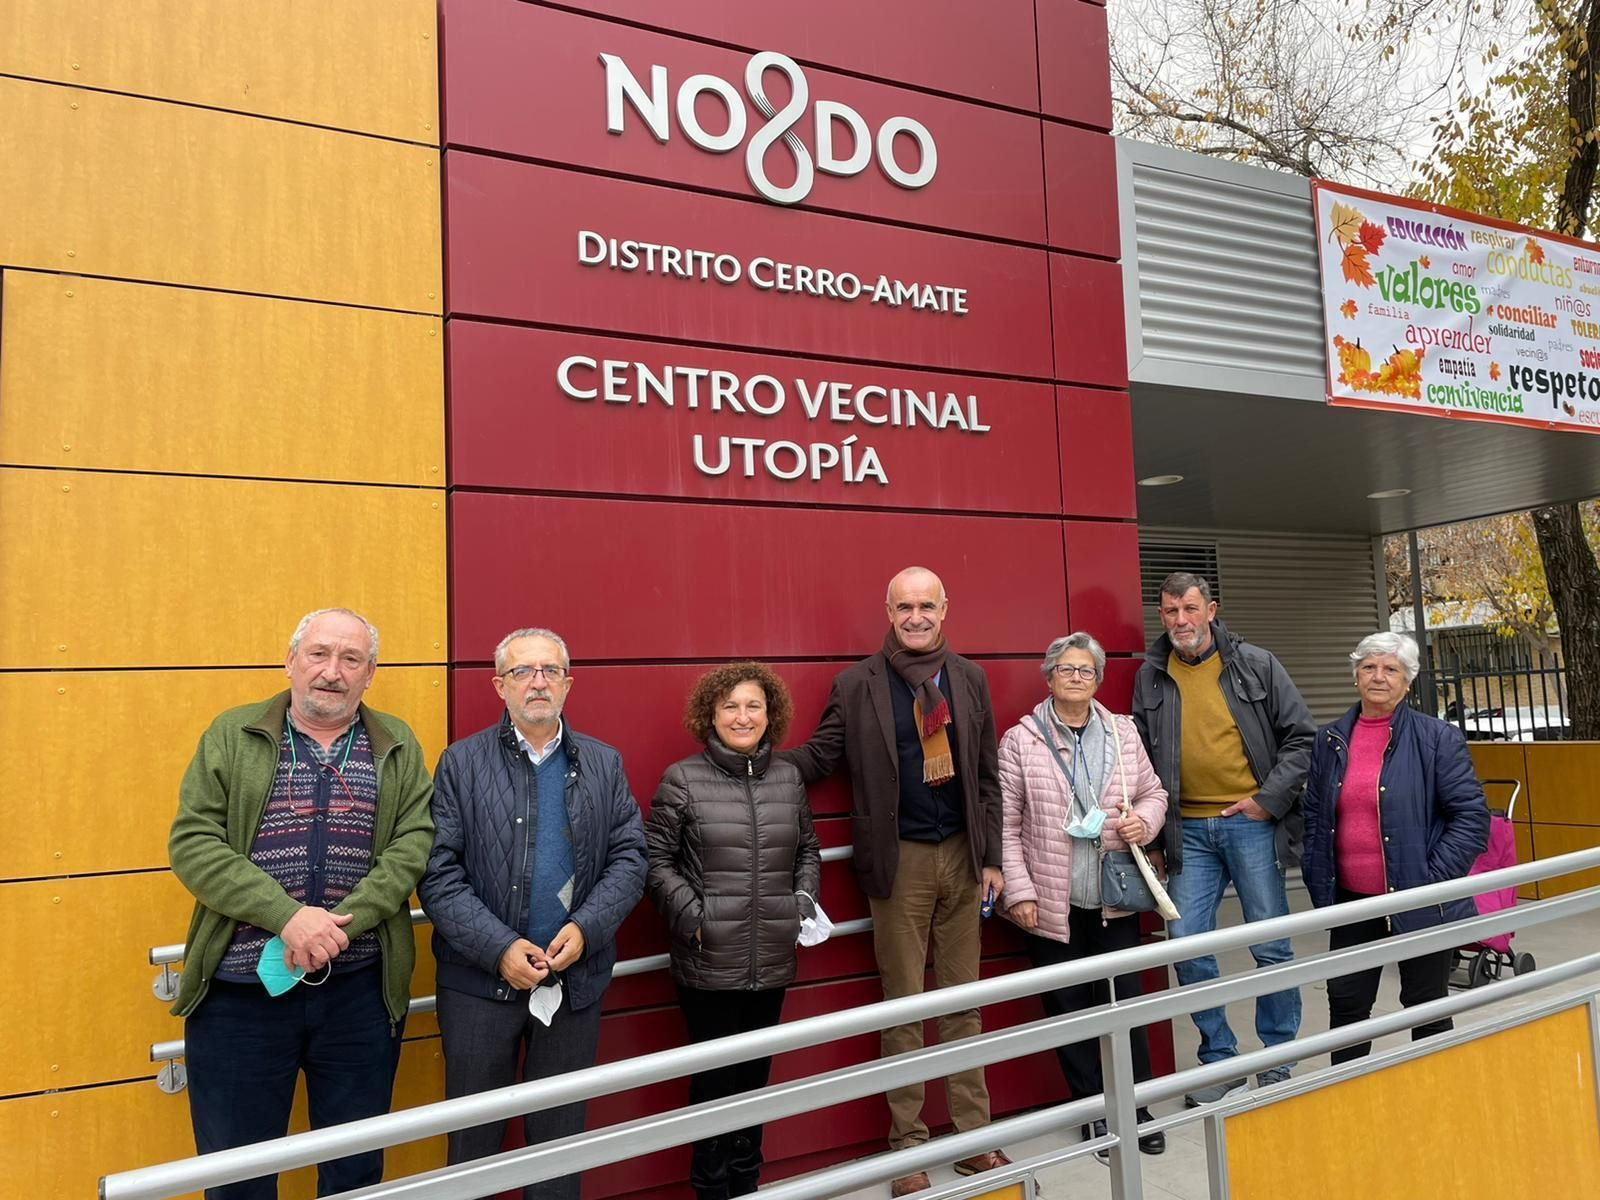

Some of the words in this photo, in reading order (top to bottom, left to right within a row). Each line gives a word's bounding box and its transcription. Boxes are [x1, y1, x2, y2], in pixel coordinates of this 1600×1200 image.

[1386, 216, 1469, 252] EDUCACIÓN
[1470, 229, 1515, 252] respirar
[577, 230, 742, 285] DISTRITO
[748, 257, 969, 315] CERRO-AMATE
[1452, 261, 1476, 279] amor
[1487, 252, 1572, 289] conductas
[1368, 303, 1410, 321] familia
[1497, 304, 1558, 330] conciliar
[1555, 295, 1591, 317] niñ@s
[1406, 316, 1491, 354] aprender
[1488, 322, 1536, 341] solidaridad
[1548, 338, 1573, 353] padres
[1515, 347, 1549, 361] vecin@s
[556, 355, 786, 417] CENTRO
[796, 378, 991, 432] VECINAL
[1427, 382, 1523, 413] convivencia
[1508, 364, 1600, 409] respeto
[693, 434, 889, 484] UTOPÍA
